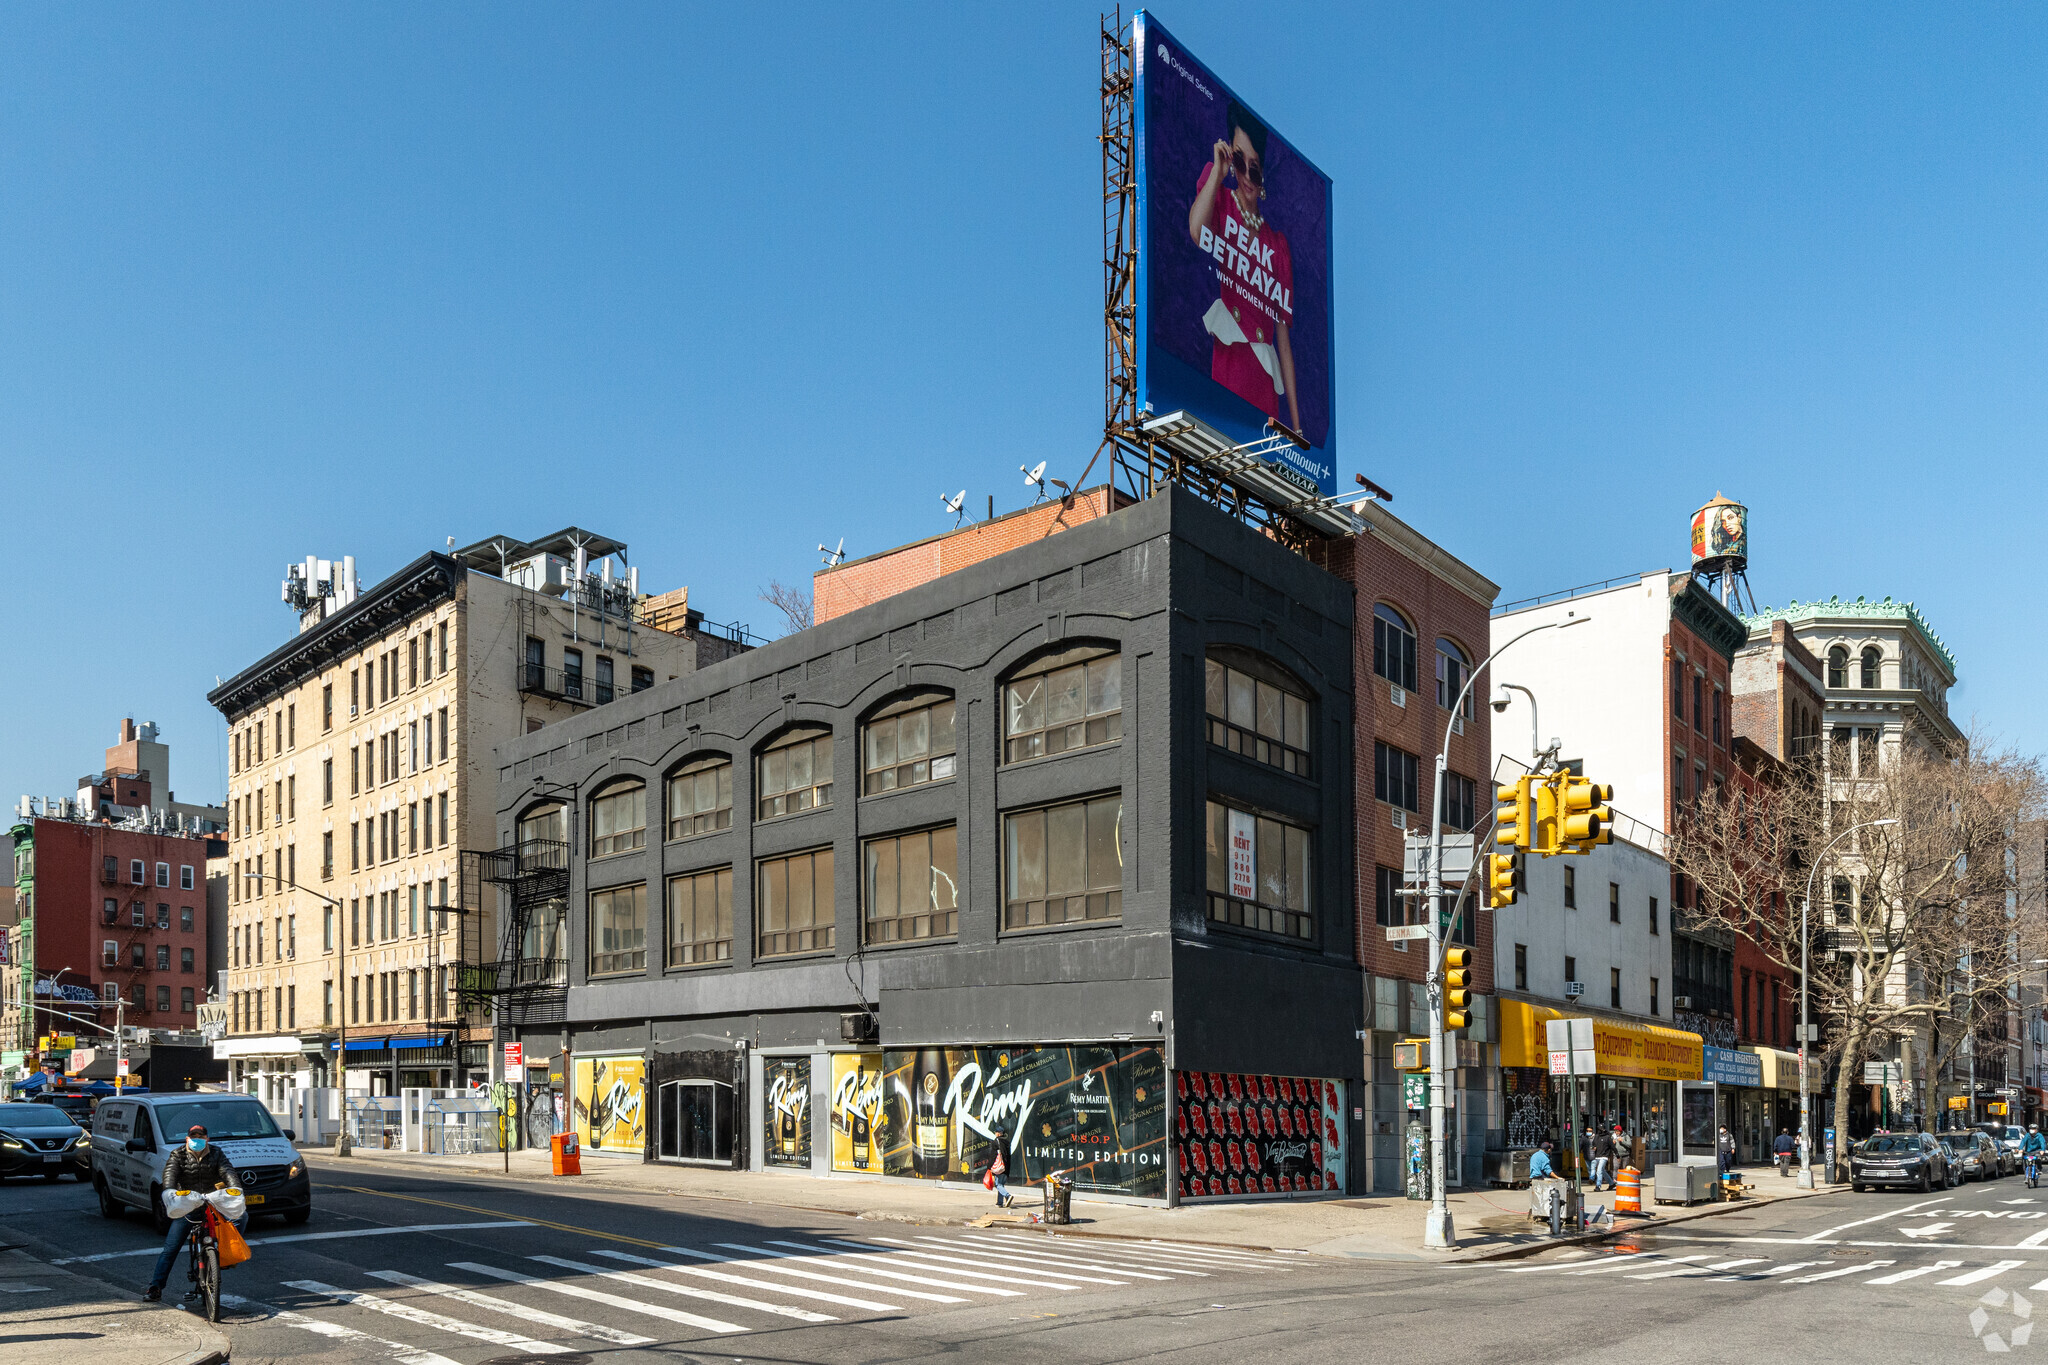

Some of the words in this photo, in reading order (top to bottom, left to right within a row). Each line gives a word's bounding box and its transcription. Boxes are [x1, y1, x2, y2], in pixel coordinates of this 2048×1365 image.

[1170, 57, 1195, 84] Original
[1195, 78, 1214, 101] Series
[1224, 214, 1275, 273] PEAK
[1199, 224, 1293, 315] BETRAYAL
[1215, 268, 1234, 289] WHY
[1235, 283, 1264, 311] WOMEN
[1265, 304, 1280, 323] KILL
[1277, 465, 1316, 491] LAMAR
[1234, 836, 1250, 851] RENT
[1233, 883, 1252, 898] PENNY
[1602, 1032, 1633, 1059] EQUIPMENT
[1643, 1038, 1667, 1062] DIAMOND
[1667, 1041, 1693, 1065] EQUIPMENT
[1720, 1050, 1733, 1062] CASH
[1734, 1052, 1760, 1066] REGISTERS
[1025, 1054, 1057, 1071] CHAMPAGNE
[607, 1076, 643, 1133] Rémy
[769, 1076, 809, 1125] Rémy
[835, 1070, 883, 1131] Rémy
[942, 1062, 1036, 1161] Rémy
[1085, 1093, 1110, 1105] MARTIN
[1070, 1133, 1111, 1144] V.S.O.P
[1026, 1146, 1084, 1161] LIMITED
[1094, 1151, 1160, 1166] EDITION
[1903, 1209, 2048, 1219] ONLY
